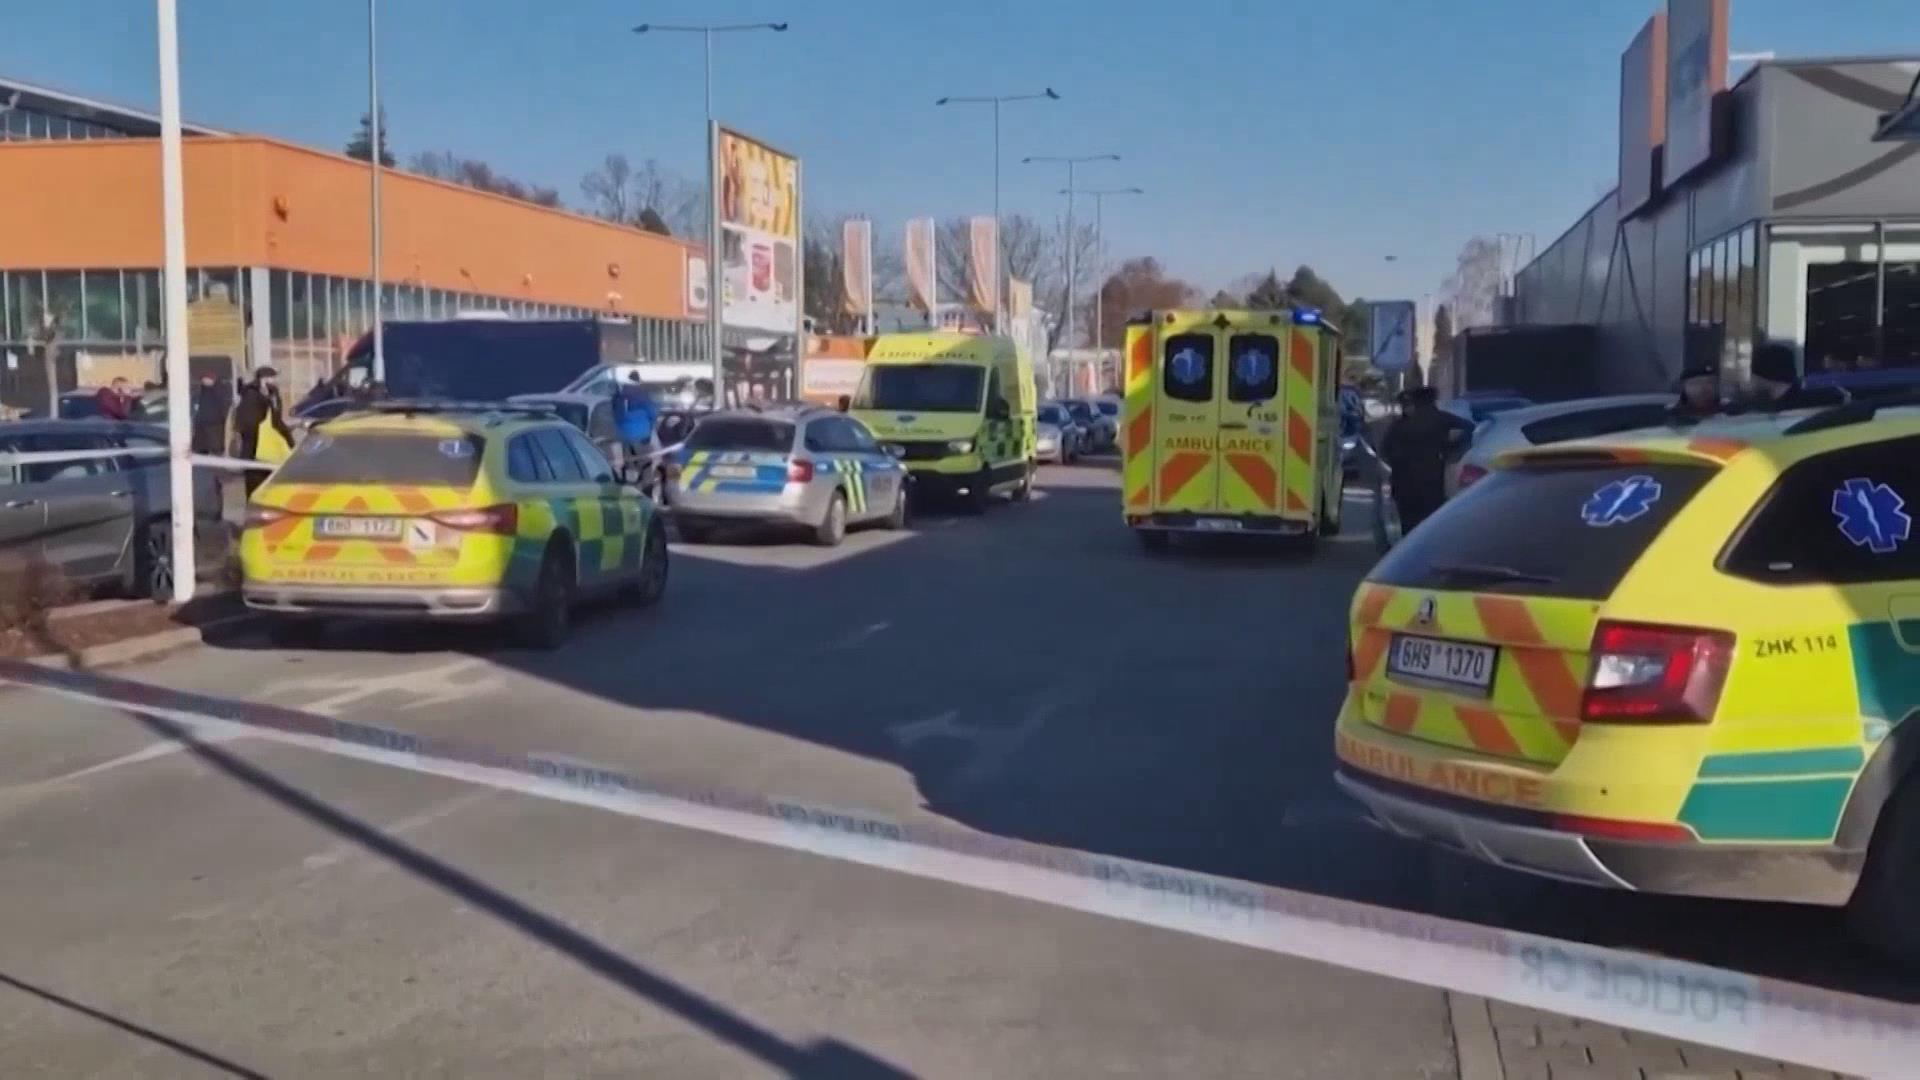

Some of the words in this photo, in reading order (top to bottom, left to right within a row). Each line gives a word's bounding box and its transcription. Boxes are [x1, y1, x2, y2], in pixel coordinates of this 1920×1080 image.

[1165, 436, 1273, 451] AMBULANCE
[1401, 636, 1431, 670] 6H9
[1444, 646, 1485, 680] 1370
[1753, 638, 1798, 658] ZHK
